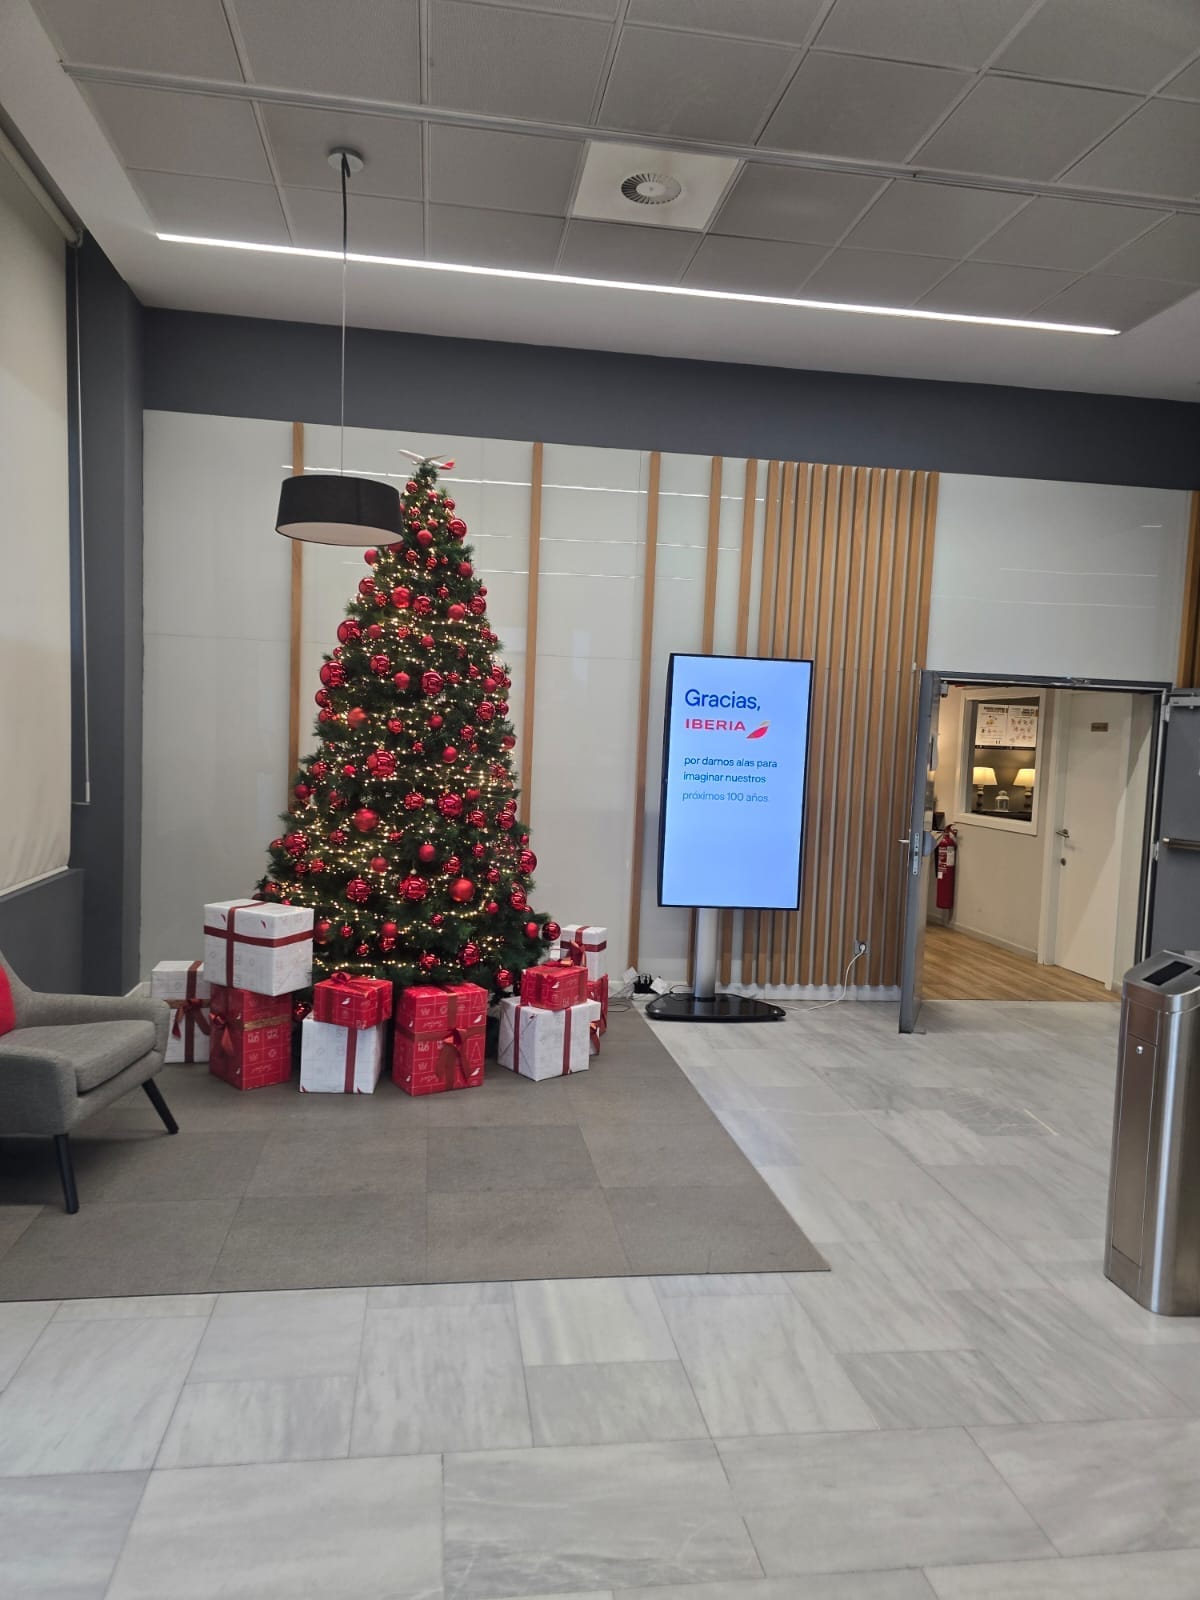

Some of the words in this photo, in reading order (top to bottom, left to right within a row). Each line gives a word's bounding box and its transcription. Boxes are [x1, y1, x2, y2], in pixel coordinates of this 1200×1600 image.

[685, 688, 761, 711] Gracias,
[685, 718, 746, 731] IBERIA
[684, 757, 701, 767] por
[701, 756, 735, 767] darnos
[736, 758, 755, 767] alas
[756, 760, 778, 769] para
[683, 771, 724, 783] imaginar
[725, 774, 767, 783] nuestros
[682, 790, 726, 801] próximos
[727, 792, 744, 801] 100
[745, 793, 769, 802] años
